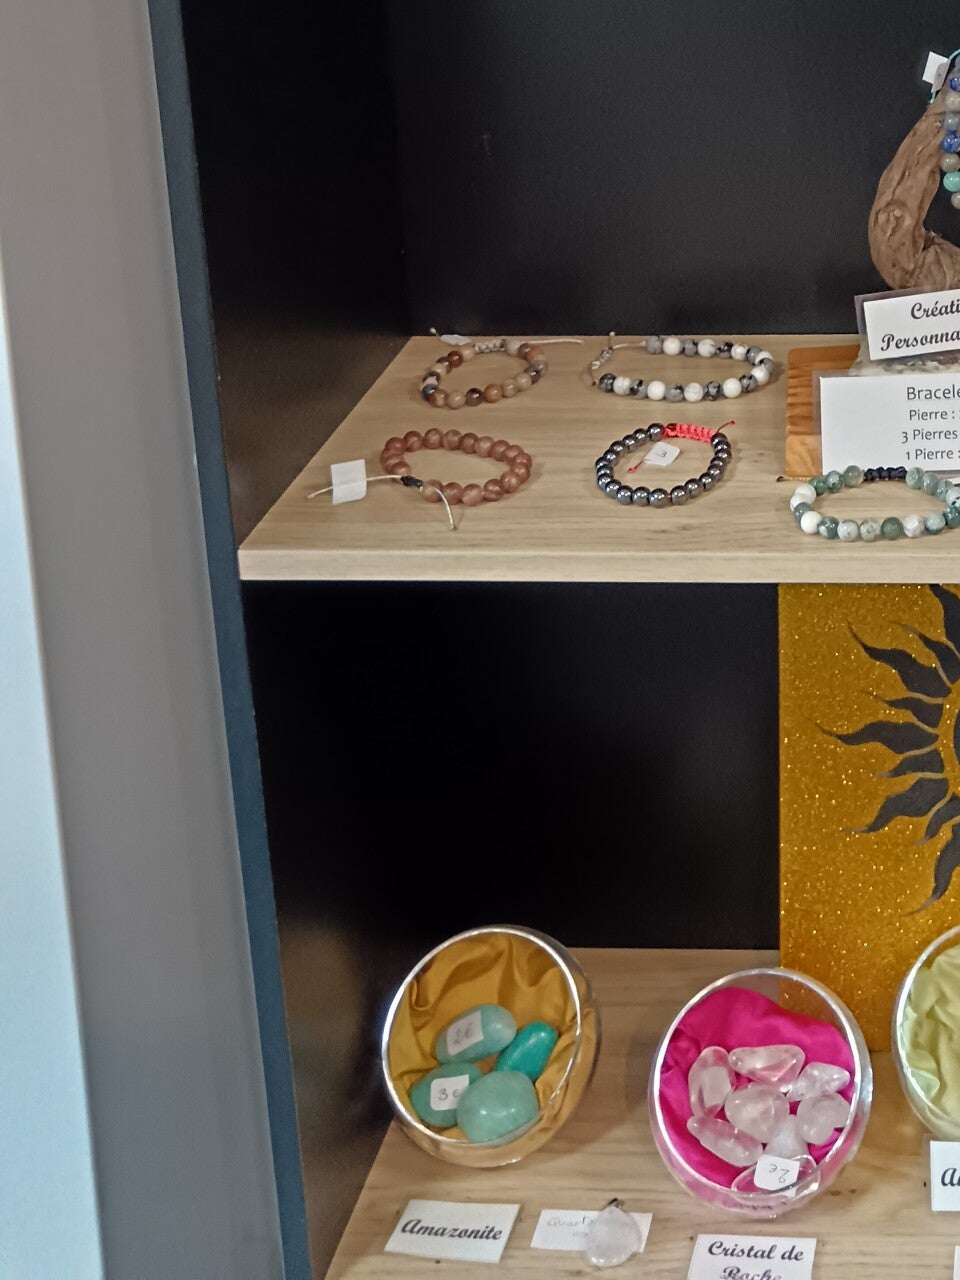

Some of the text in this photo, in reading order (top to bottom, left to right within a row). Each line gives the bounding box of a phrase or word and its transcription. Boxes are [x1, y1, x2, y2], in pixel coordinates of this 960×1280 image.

[909, 409, 948, 421] Pierre
[901, 431, 909, 444] 3
[912, 428, 959, 440] Pierres
[906, 451, 911, 460] 1
[915, 448, 954, 460] Pierre
[400, 1218, 503, 1241] Amazonite
[707, 1240, 804, 1261] Cristal de
